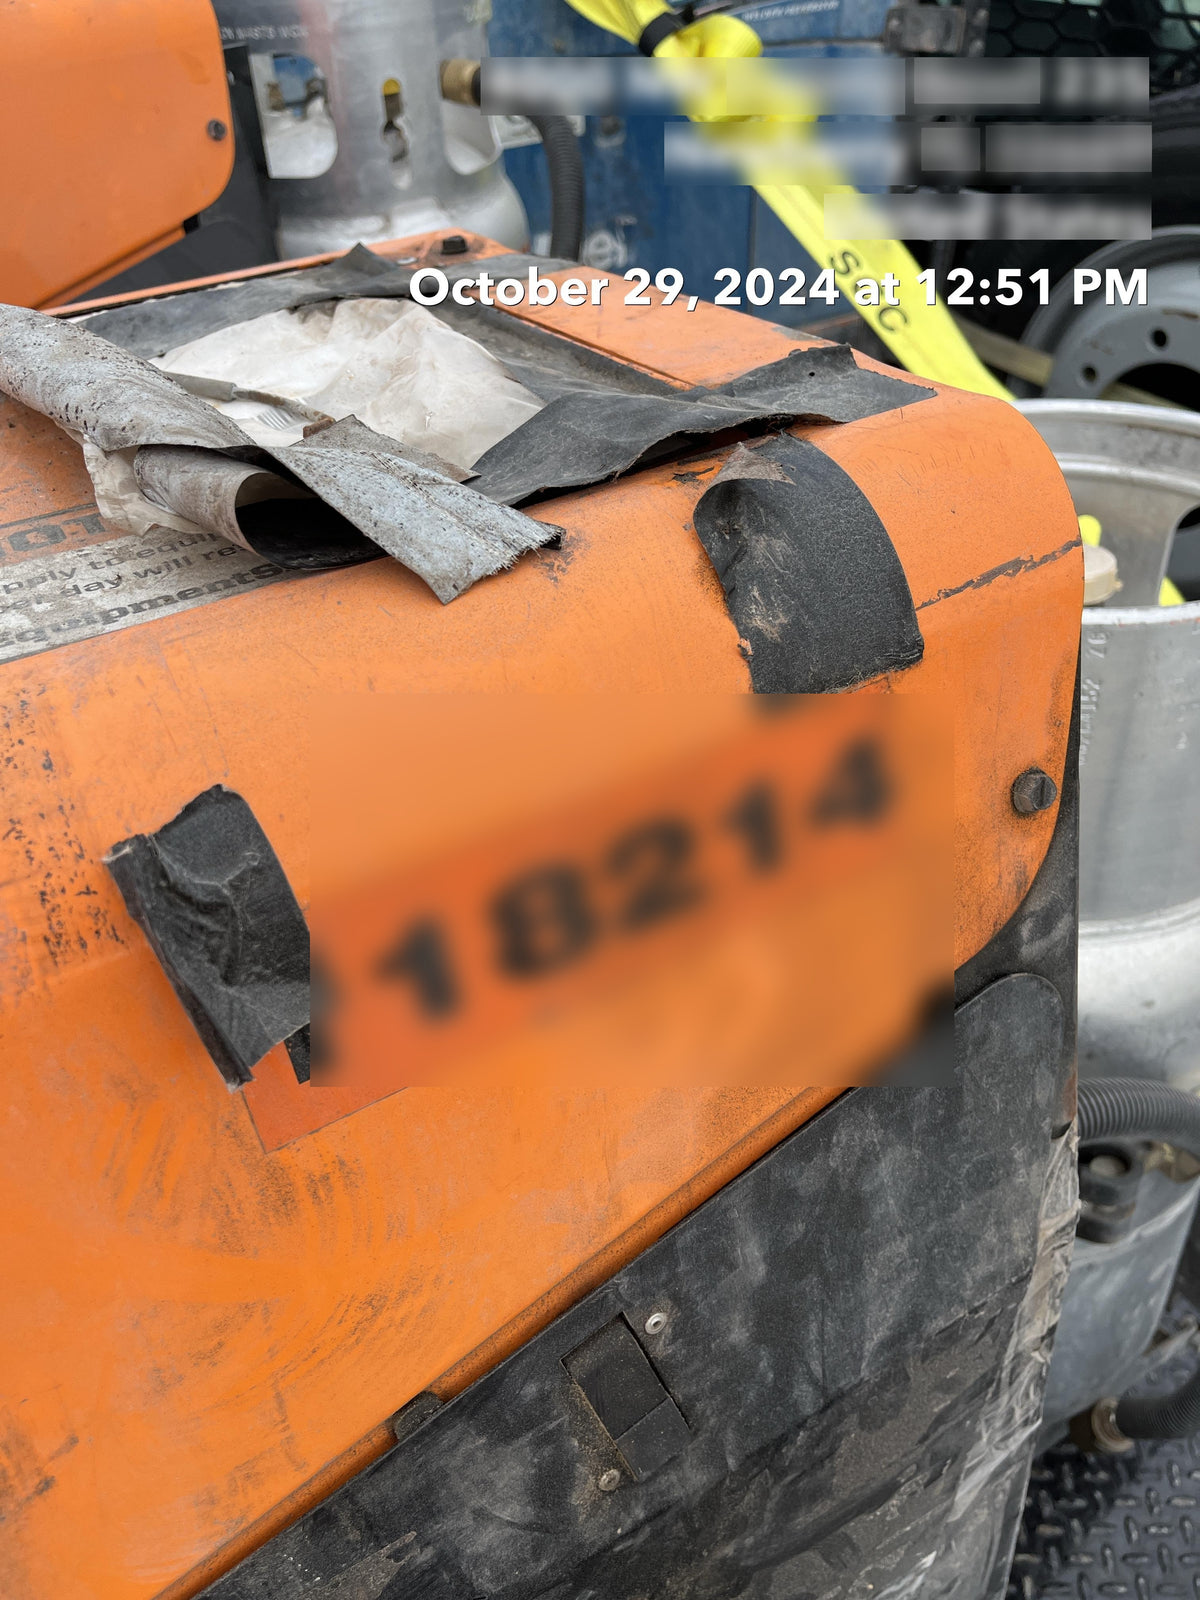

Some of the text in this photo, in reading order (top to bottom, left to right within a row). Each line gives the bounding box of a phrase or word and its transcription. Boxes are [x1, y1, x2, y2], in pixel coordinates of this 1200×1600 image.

[60, 574, 123, 598] day
[133, 556, 192, 579] will
[285, 737, 893, 1086] 18214
